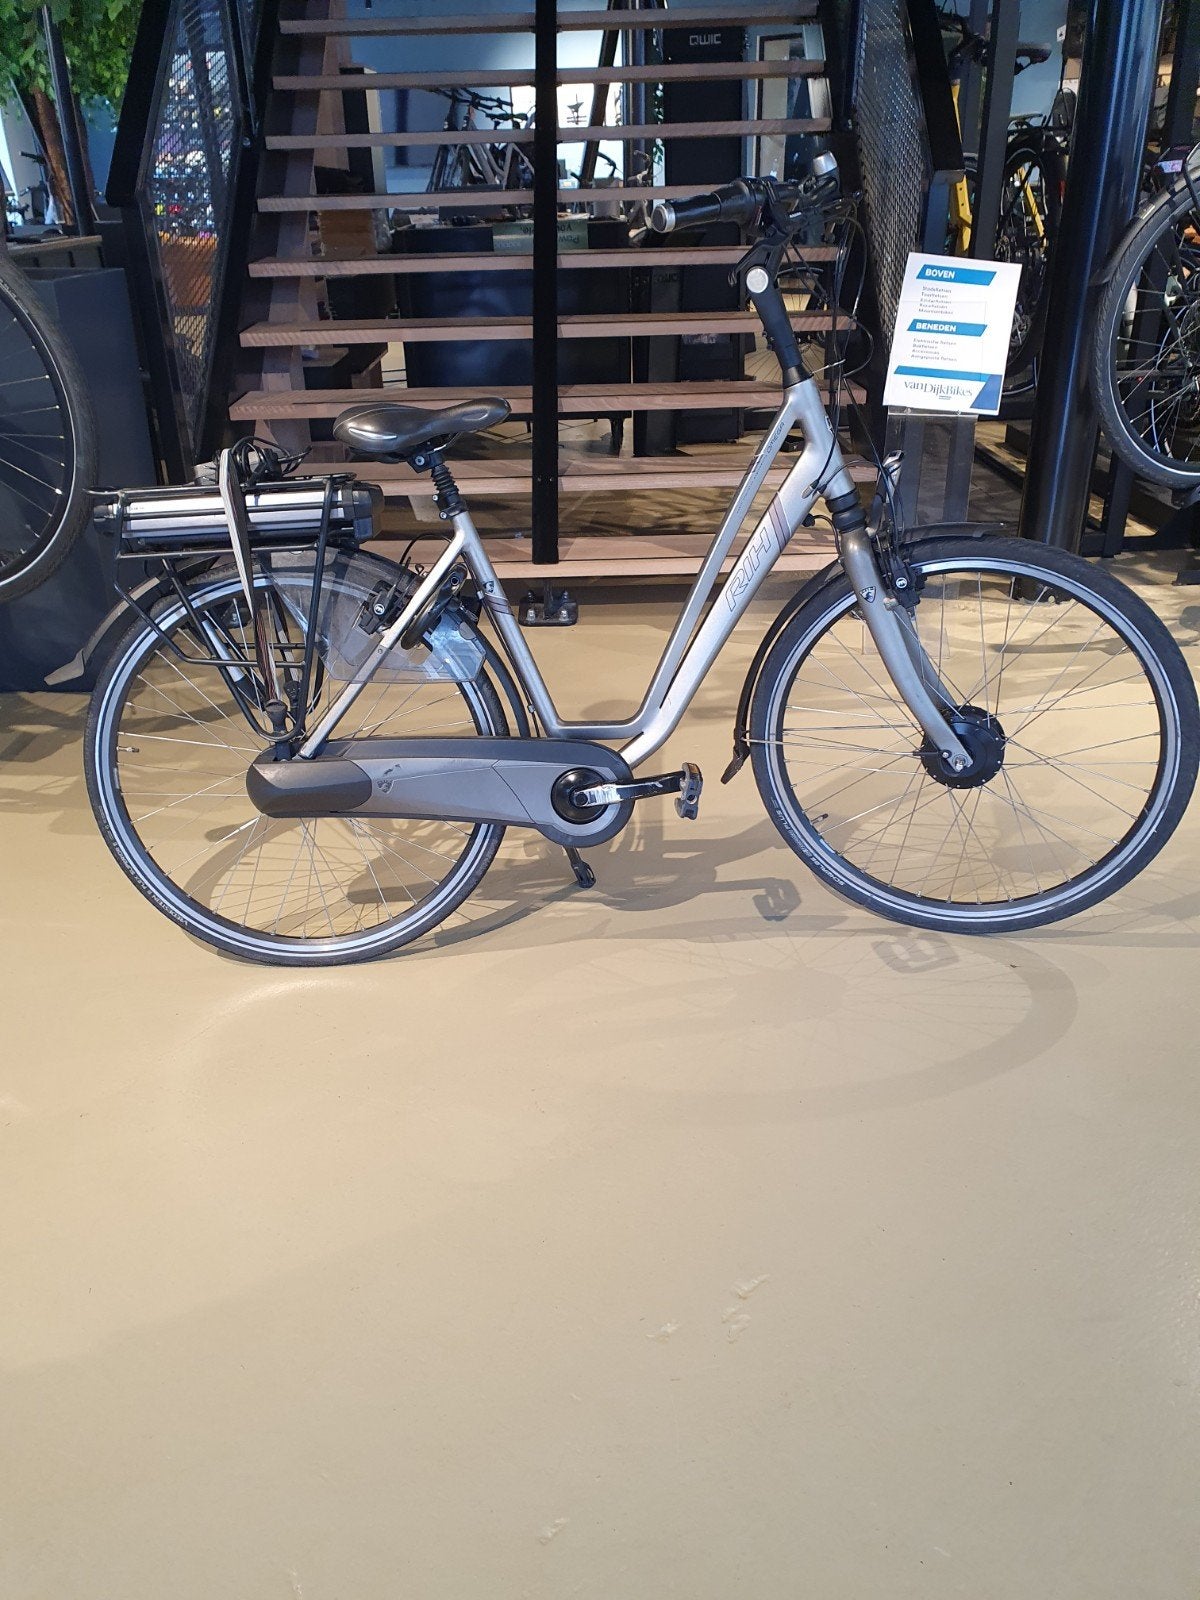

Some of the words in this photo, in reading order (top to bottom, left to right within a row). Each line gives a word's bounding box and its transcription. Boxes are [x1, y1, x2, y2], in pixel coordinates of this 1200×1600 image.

[689, 33, 722, 46] QWIC
[925, 268, 956, 279] BOVEN
[915, 322, 957, 332] BENEDEN
[904, 381, 973, 396] vanDijkBikes
[725, 526, 772, 613] RIH
